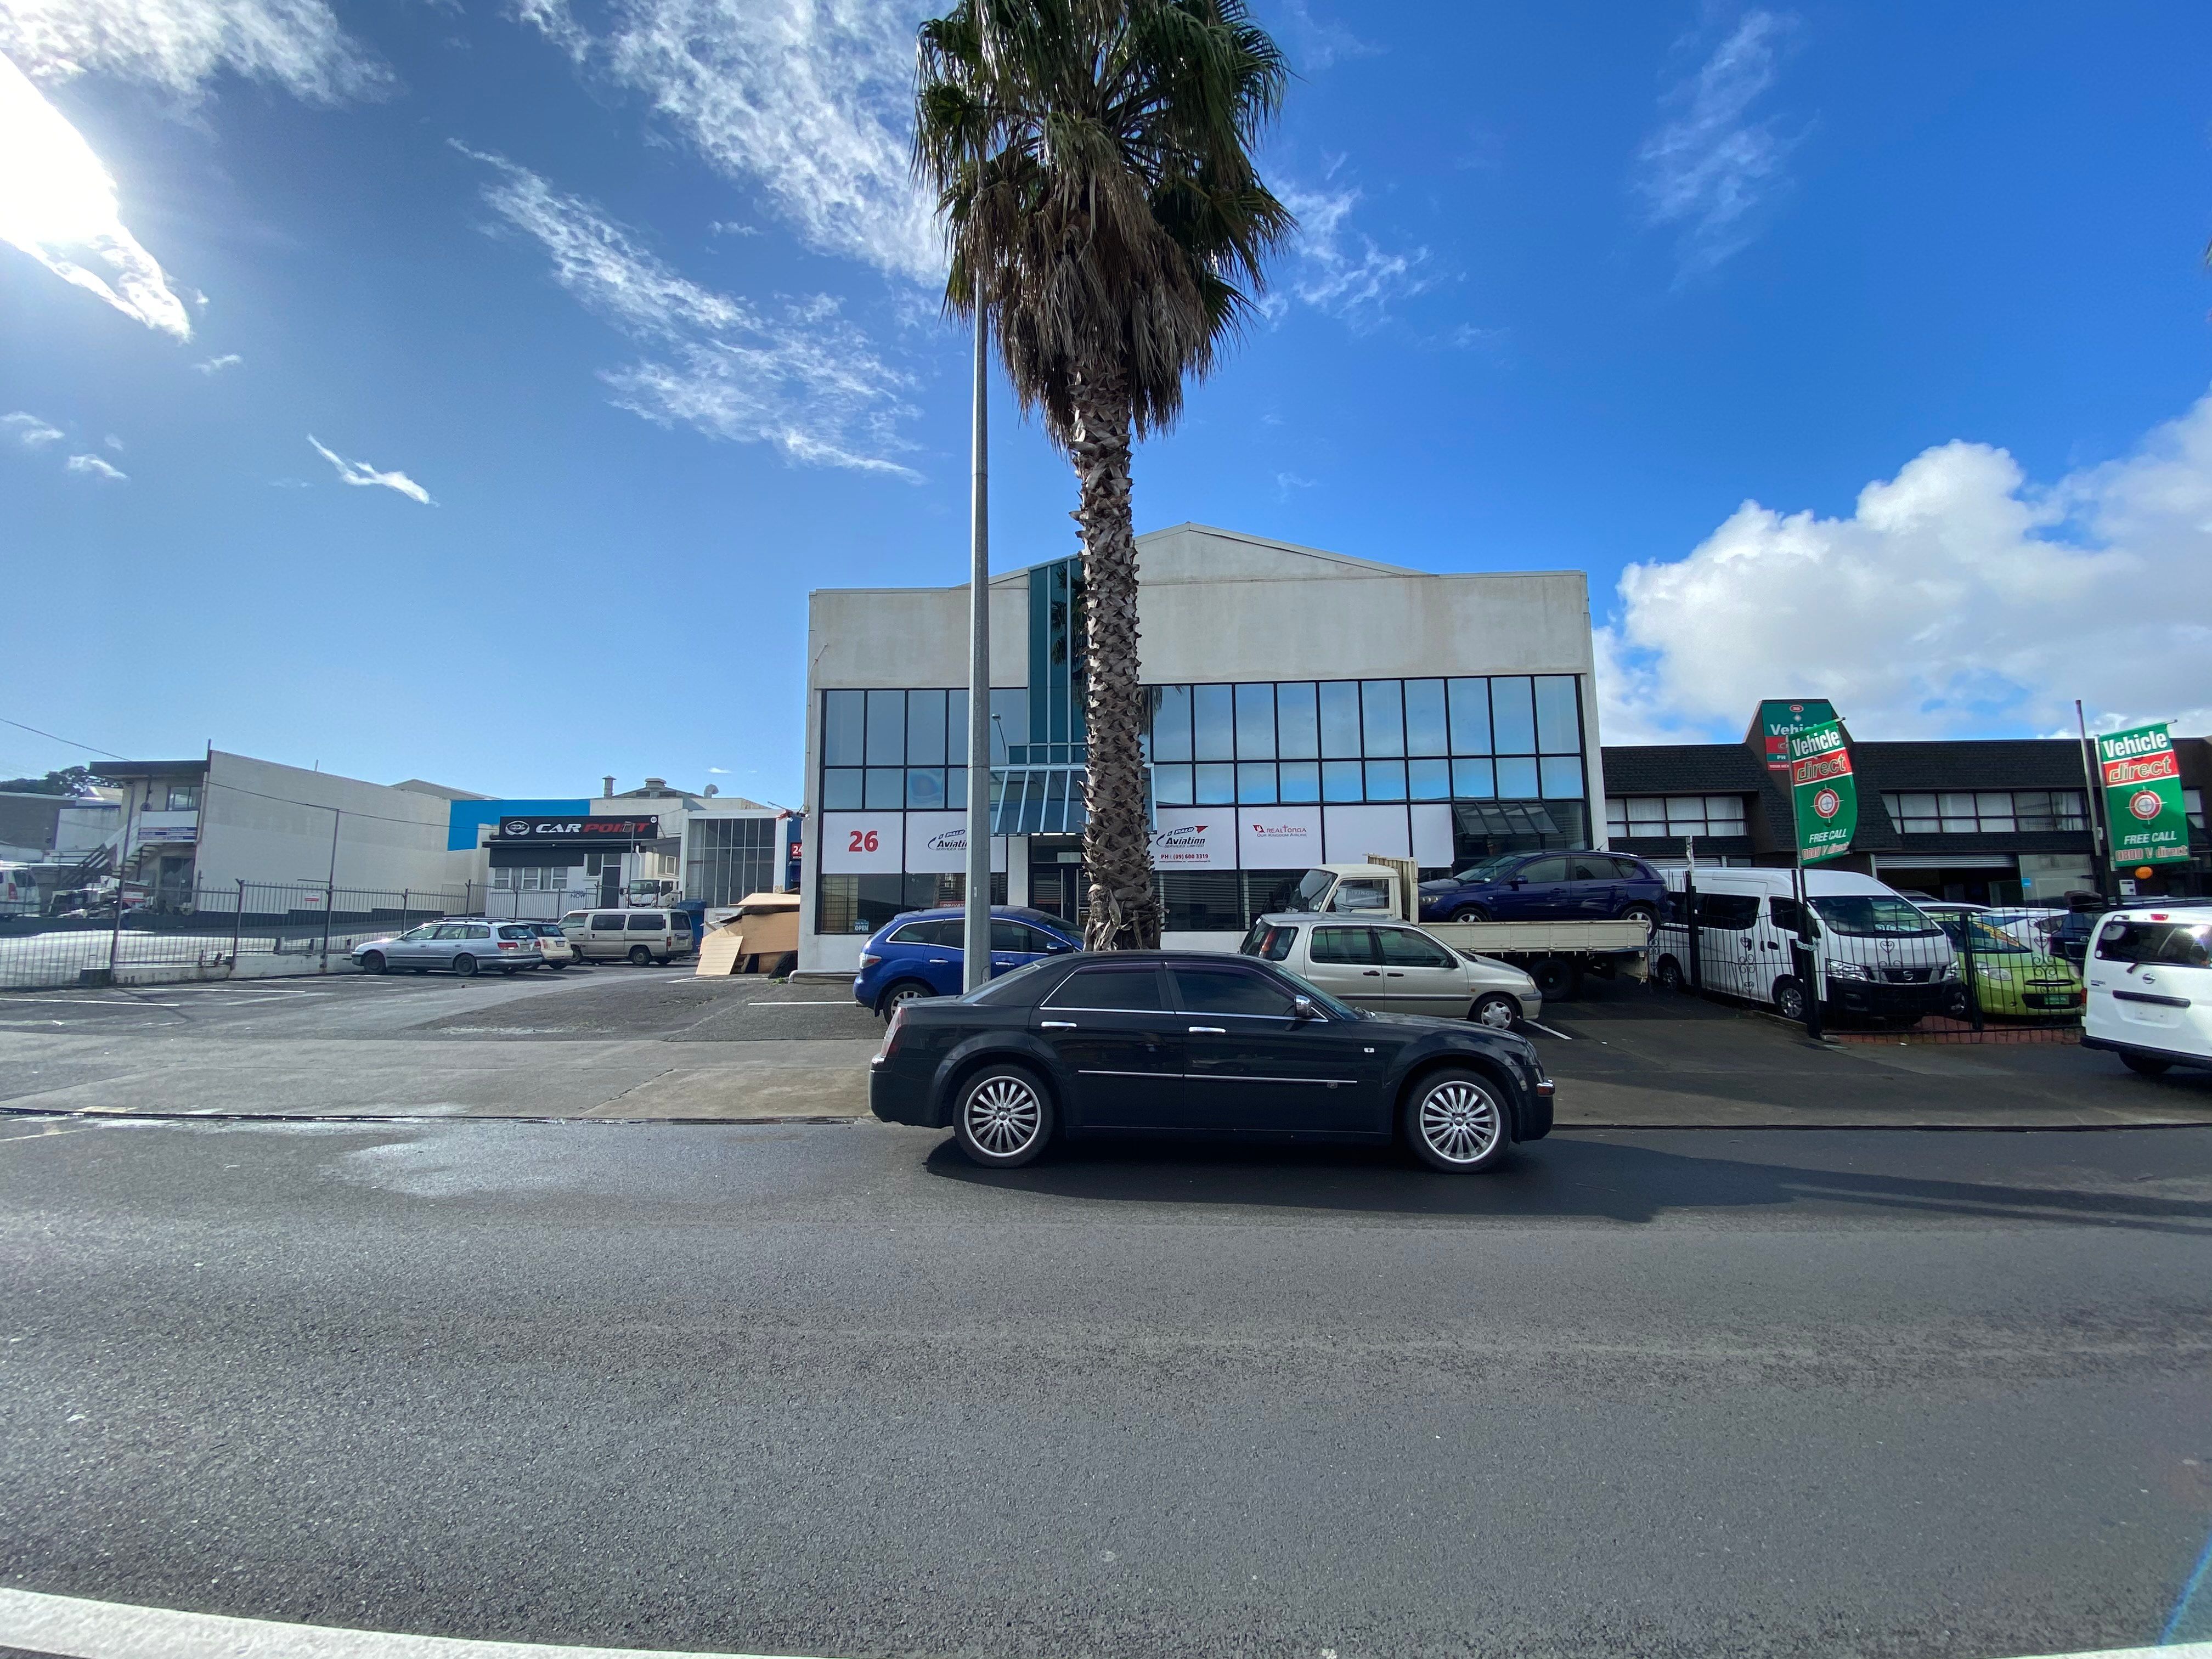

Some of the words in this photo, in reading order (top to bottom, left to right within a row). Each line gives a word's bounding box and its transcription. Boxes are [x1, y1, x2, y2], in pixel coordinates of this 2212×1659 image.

[1792, 729, 1841, 757] Vehicle
[2102, 731, 2168, 758] Vehicle
[1797, 753, 1847, 781] direct
[2109, 755, 2172, 783] direct
[535, 823, 582, 833] CAR
[1809, 832, 1829, 843] FREE
[1829, 828, 1847, 840] CALL
[2124, 833, 2151, 845] FREE
[2151, 831, 2177, 842] CALL
[849, 831, 878, 852] 26
[2115, 848, 2143, 861] 0800
[2145, 847, 2153, 859] V
[2155, 845, 2187, 858] direct
